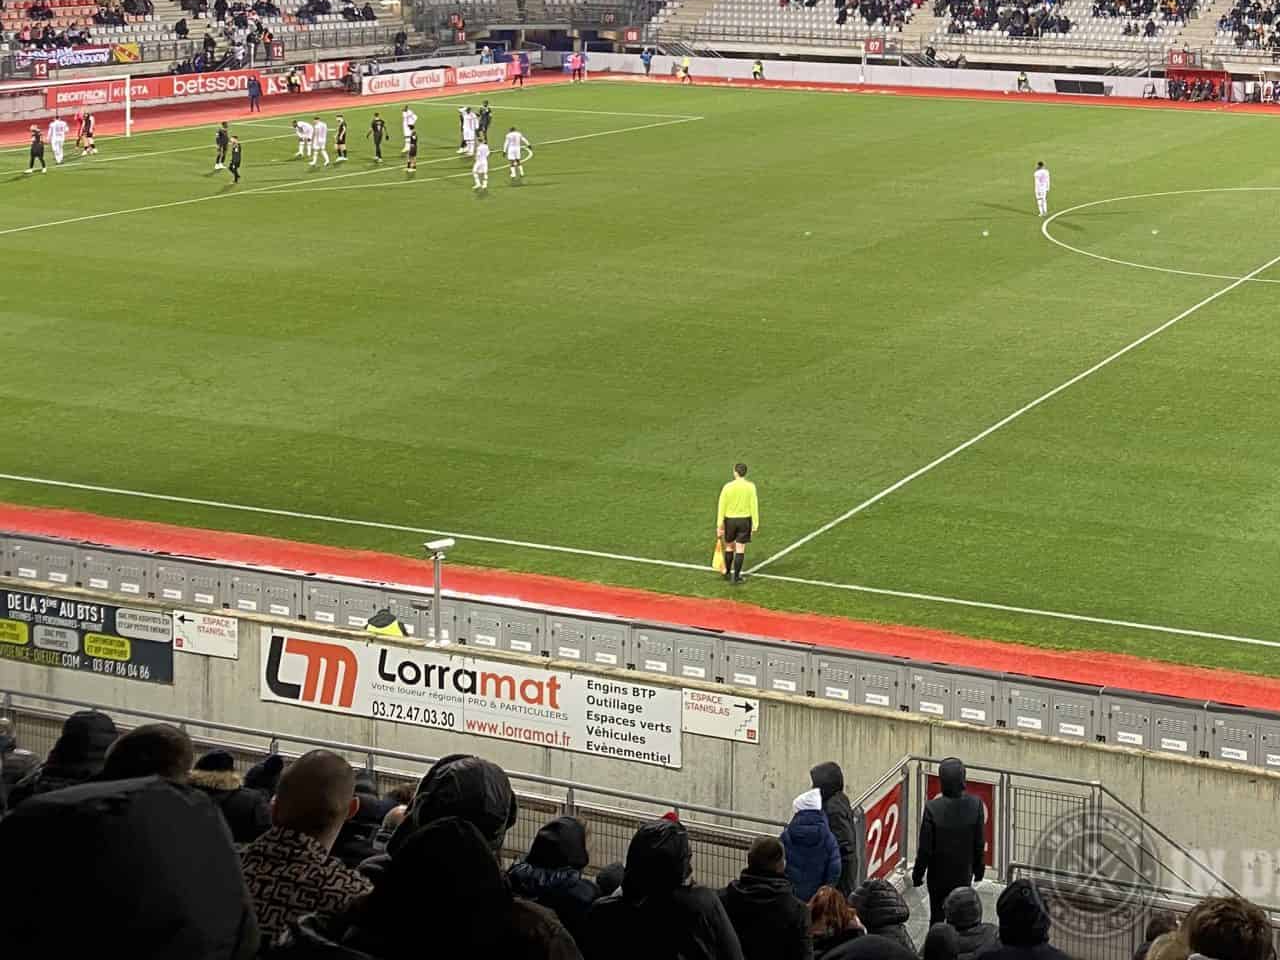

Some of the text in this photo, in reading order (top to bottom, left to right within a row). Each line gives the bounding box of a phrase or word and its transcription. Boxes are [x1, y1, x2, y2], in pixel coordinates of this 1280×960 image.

[272, 46, 283, 57] 12
[34, 63, 47, 75] 13
[173, 74, 248, 95] betsson
[368, 77, 400, 93] Carola
[410, 72, 441, 88] Carola
[113, 85, 149, 97] KISTA
[8, 593, 21, 610] DE
[24, 596, 37, 613] LA
[59, 602, 74, 618] AU
[77, 605, 97, 622] BTS
[378, 648, 561, 710] Lorramat
[586, 679, 656, 700] Engins BTP
[372, 682, 395, 692] Votre
[397, 686, 426, 697] loueur
[468, 697, 487, 708] PRO
[500, 702, 569, 721] PARTICULIERS
[586, 695, 643, 714] Outillage
[690, 692, 722, 705] ESPACE
[372, 700, 455, 728] 03.72.47.03.30
[586, 710, 672, 734] Espaces verts
[466, 719, 571, 747] www.lorramat.fr
[586, 725, 646, 745] Véhicules
[867, 803, 899, 878] 22
